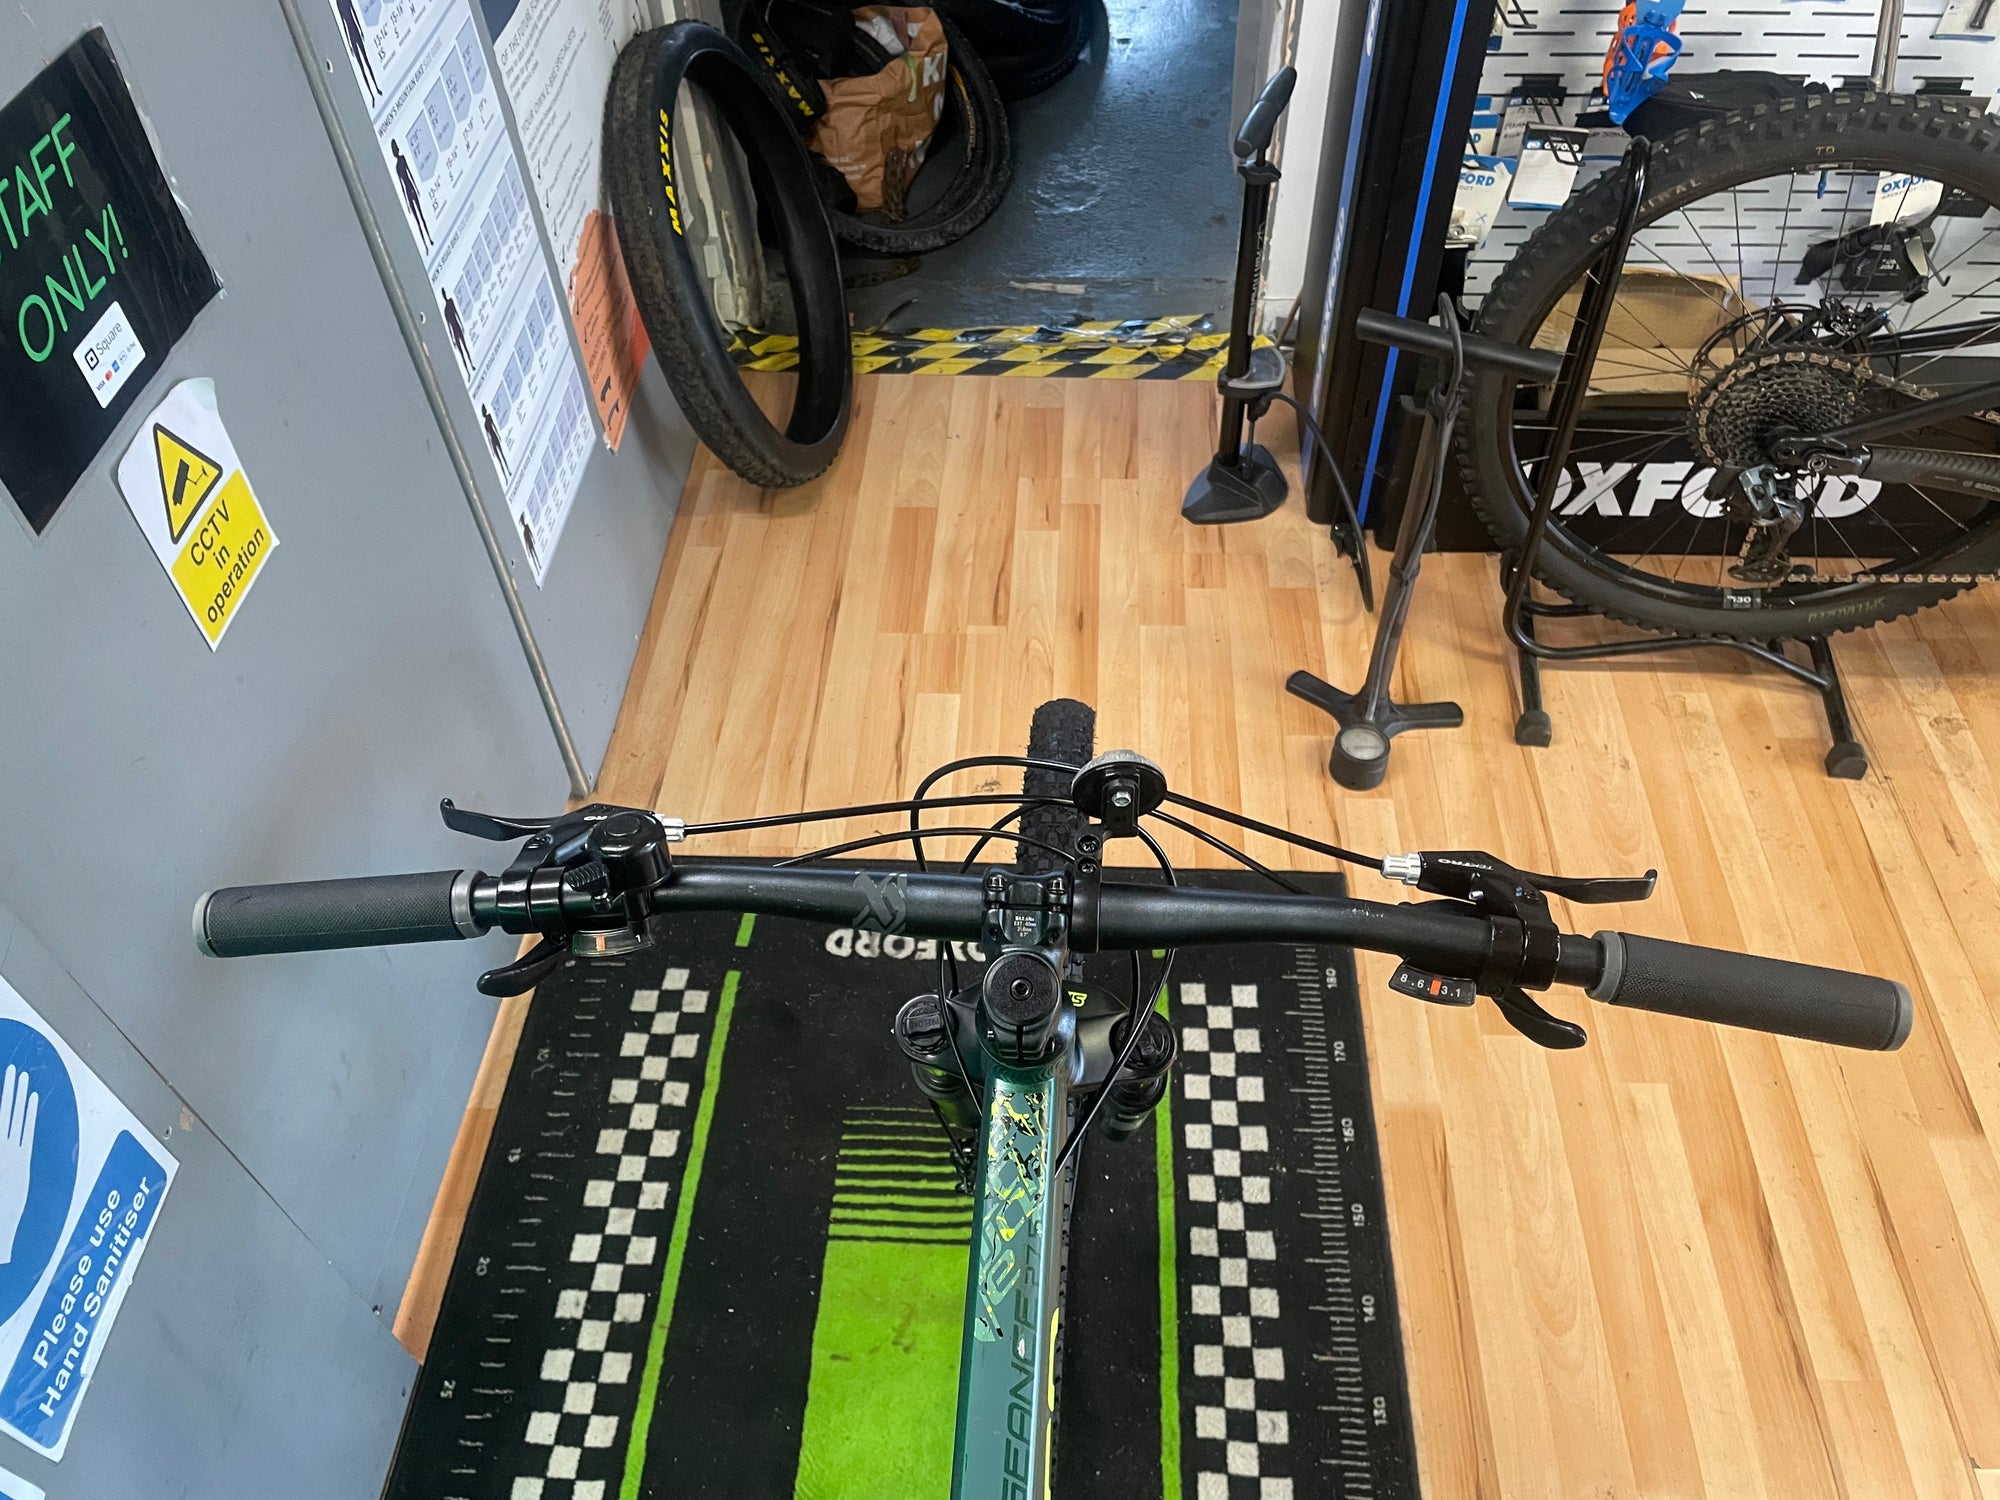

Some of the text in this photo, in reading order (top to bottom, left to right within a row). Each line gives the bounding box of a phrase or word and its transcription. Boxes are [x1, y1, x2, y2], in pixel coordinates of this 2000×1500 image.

[752, 33, 814, 117] MAXXIS
[378, 107, 397, 137] WOMEN'S
[395, 79, 415, 110] MOUNTAIN
[414, 64, 424, 81] BIKE
[659, 109, 683, 236] MAXXIS
[1460, 173, 1495, 186] FORD
[1881, 176, 1930, 193] OXFO
[0, 113, 75, 265] TAFF
[18, 203, 129, 363] ONLY!
[94, 321, 123, 356] Square
[1523, 461, 1882, 518] OXFOD
[189, 500, 234, 567] CCTV
[213, 547, 231, 571] in
[207, 528, 265, 624] operation
[1438, 858, 1494, 871] TEKTRO
[1326, 968, 1339, 990] 180
[1333, 1041, 1346, 1063] 170
[1342, 1117, 1355, 1142] 160
[1352, 1202, 1366, 1227] 150
[32, 1188, 121, 1369] Please use
[38, 1177, 151, 1419] Hand Sanitiser
[1362, 1295, 1376, 1323] 140
[440, 1379, 456, 1400] 25
[1372, 1397, 1387, 1425] 130
